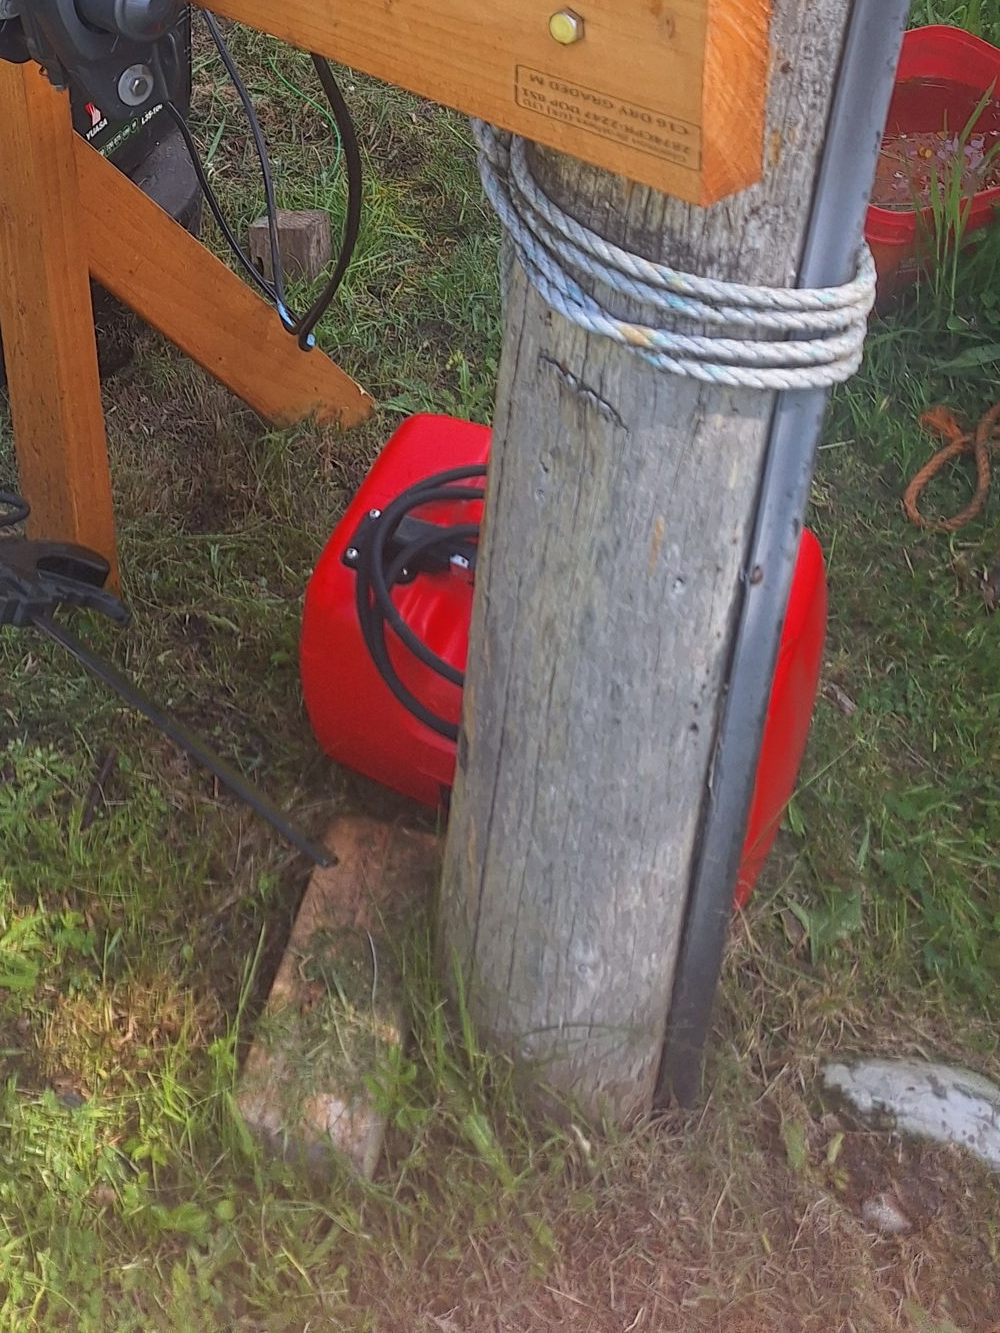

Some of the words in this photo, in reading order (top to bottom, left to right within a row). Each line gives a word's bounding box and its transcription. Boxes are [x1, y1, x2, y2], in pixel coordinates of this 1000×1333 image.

[529, 73, 544, 86] M
[548, 80, 614, 110] GRADED
[619, 104, 651, 124] DRY
[86, 117, 108, 141] YUASA
[655, 117, 688, 137] C16
